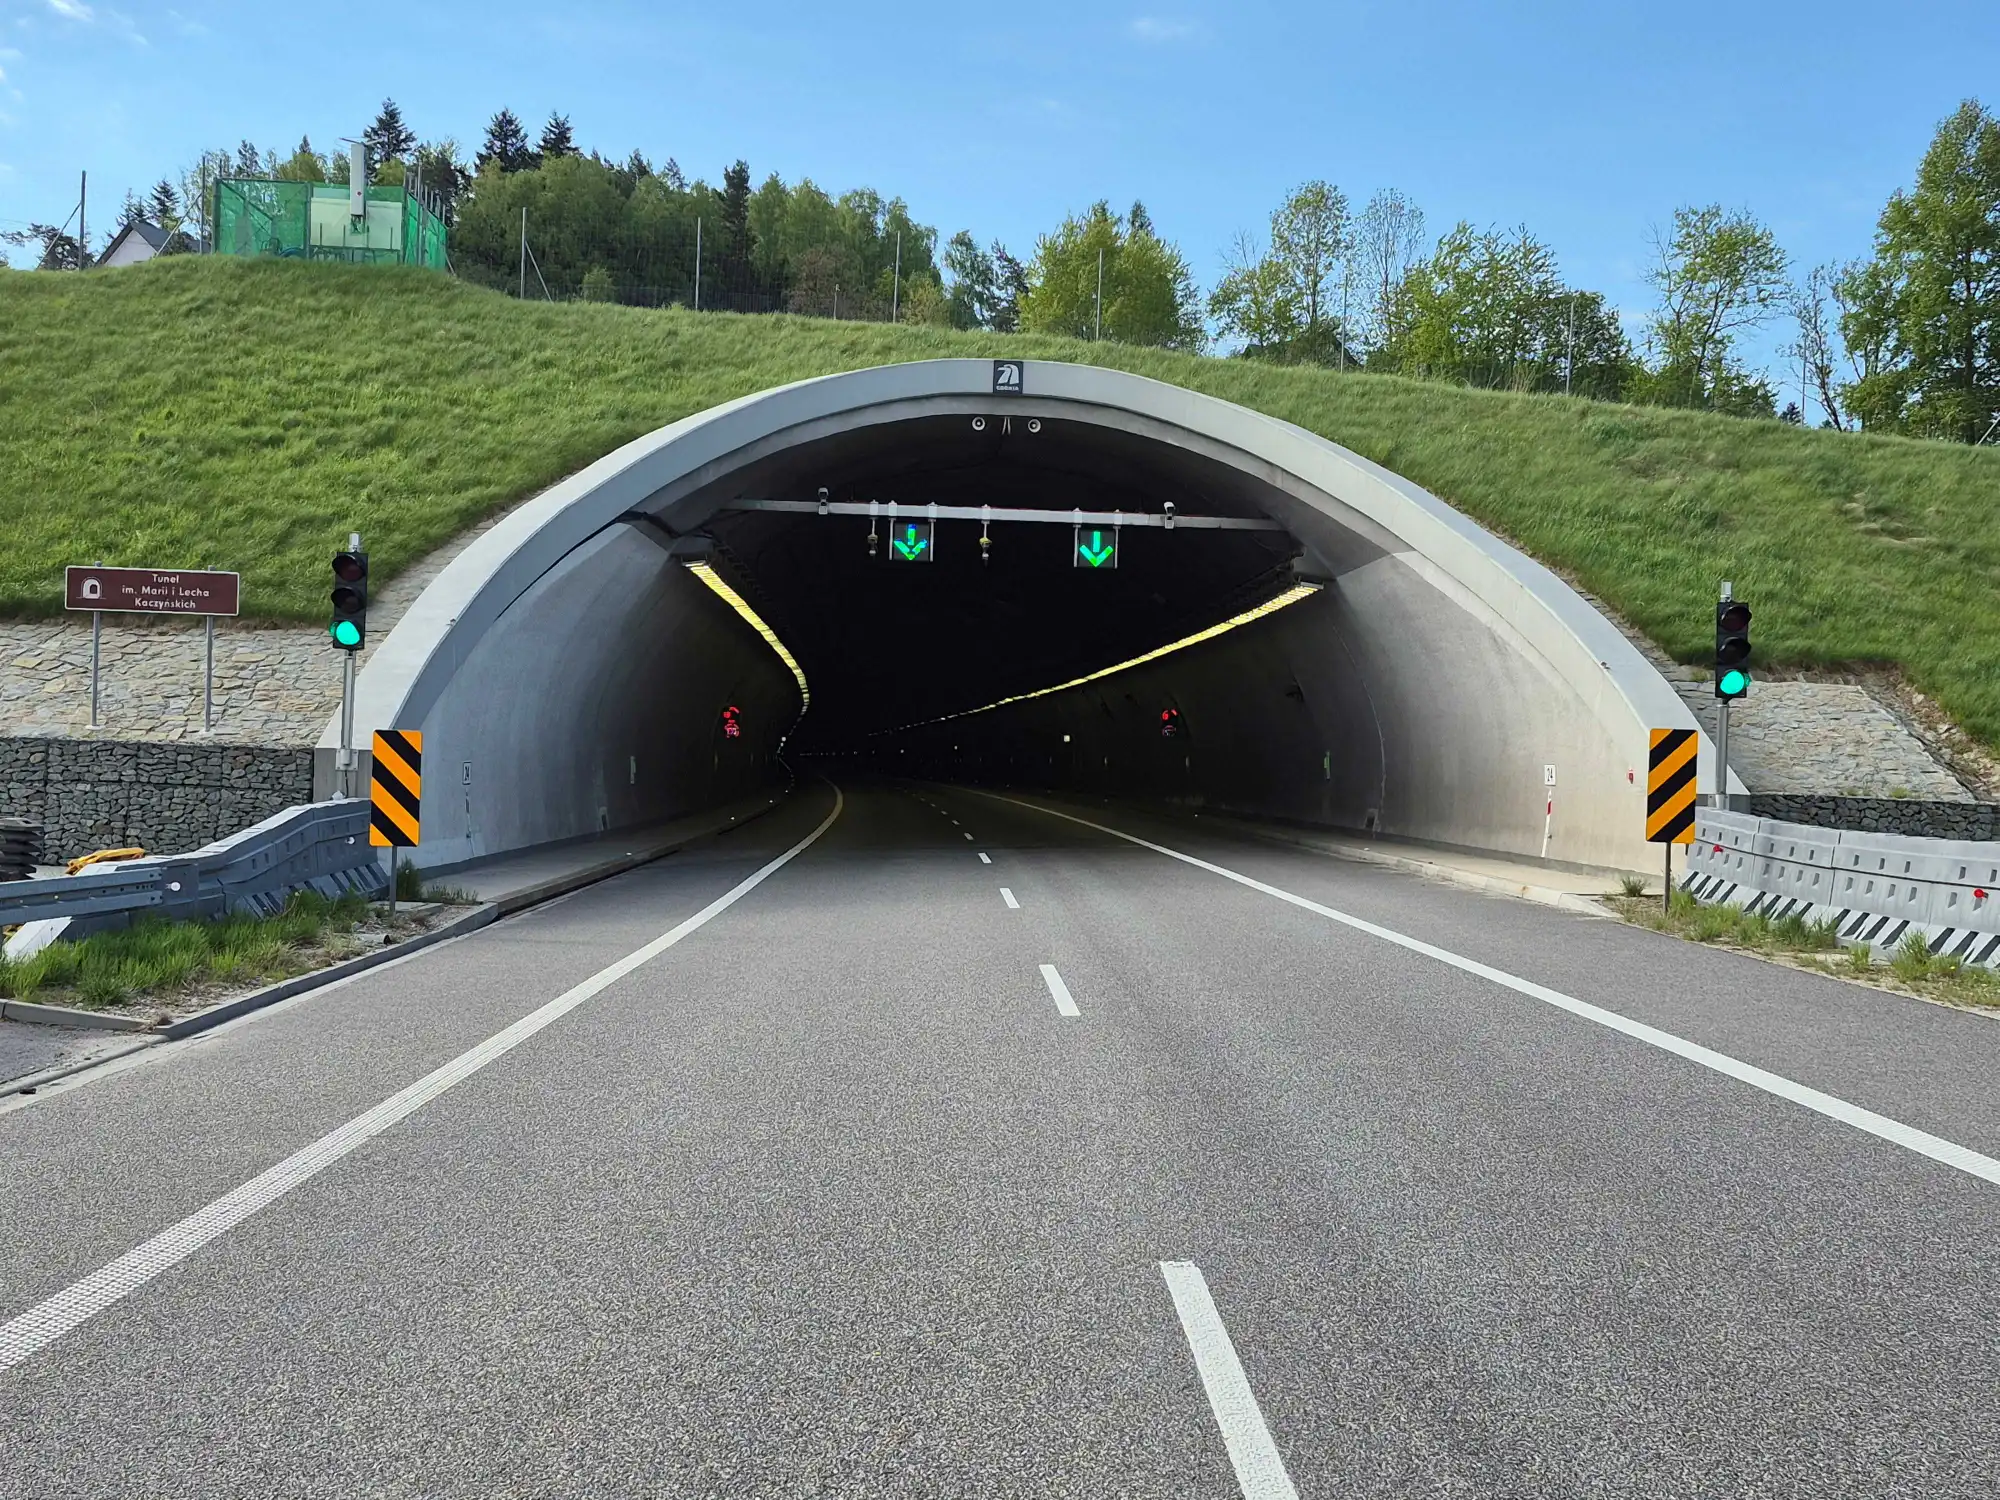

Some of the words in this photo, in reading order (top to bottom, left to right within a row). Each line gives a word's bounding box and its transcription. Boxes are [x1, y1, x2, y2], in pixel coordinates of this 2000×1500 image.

[152, 573, 180, 583] Tunel
[121, 585, 137, 594] im.
[141, 586, 168, 595] Marii
[179, 587, 210, 597] Lecha
[134, 597, 196, 610] Kaczyńskich
